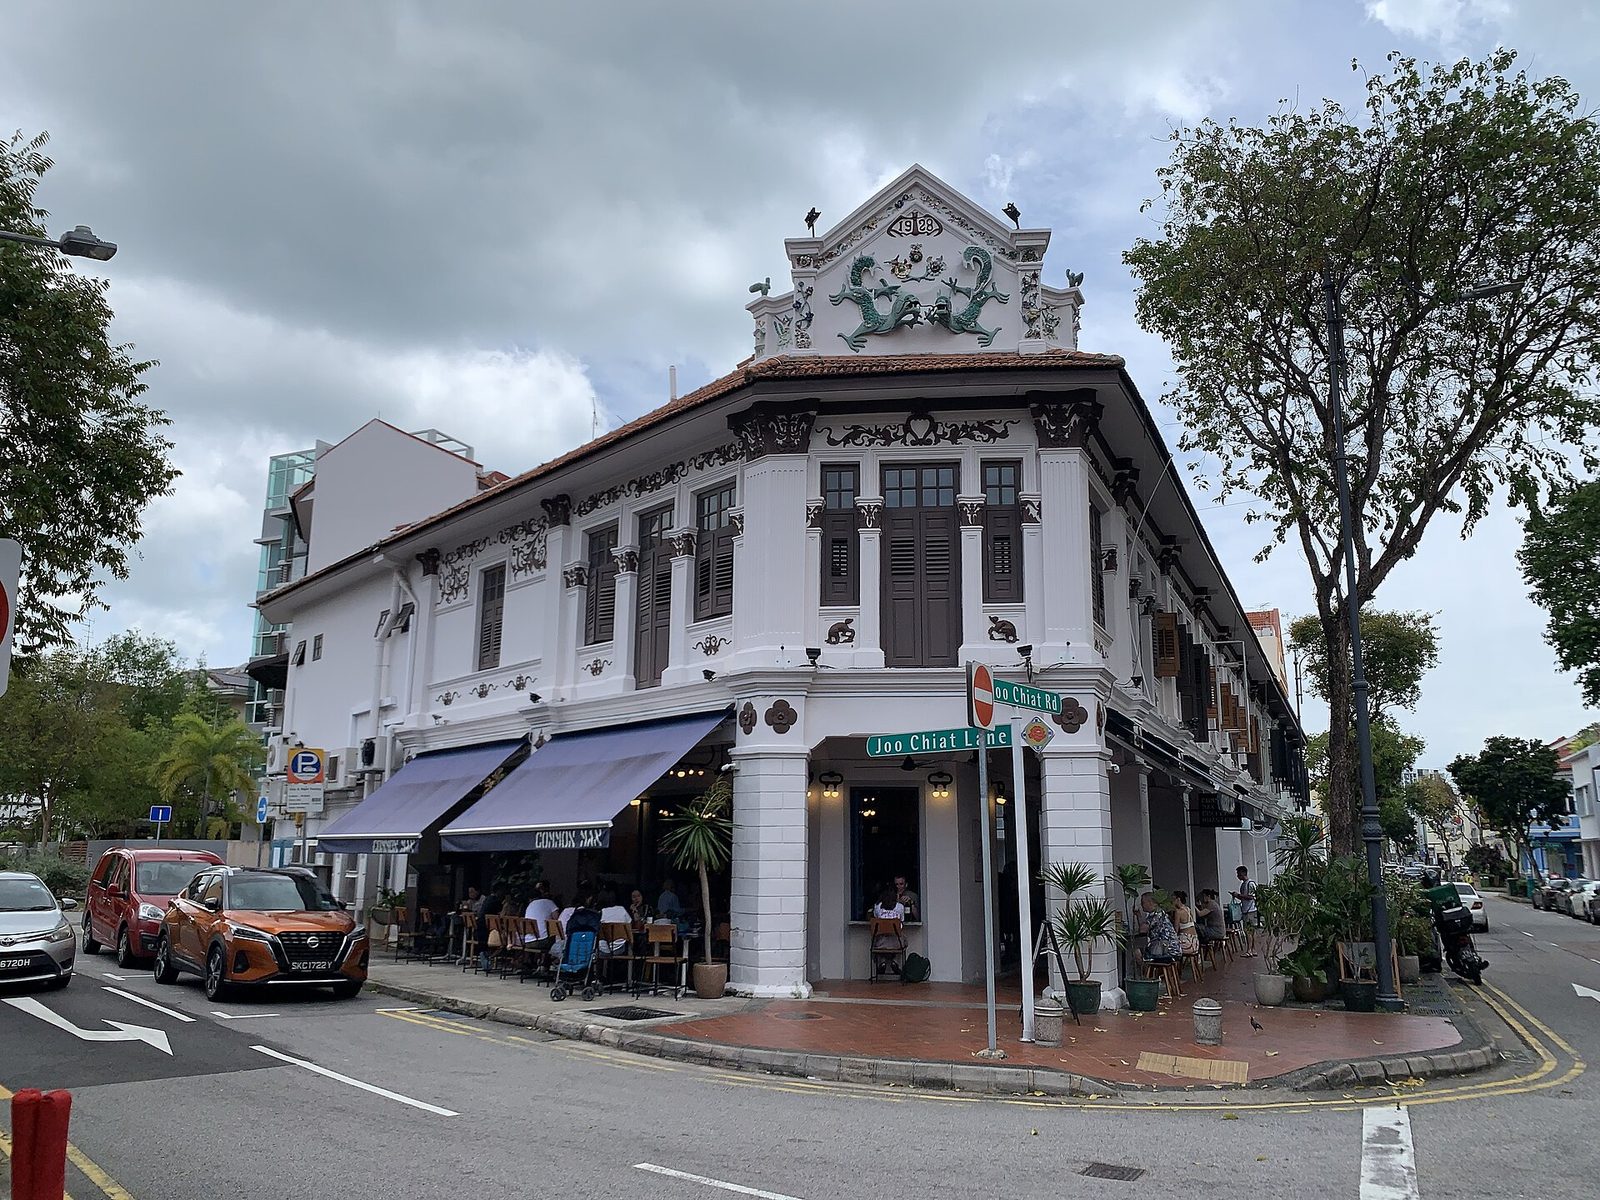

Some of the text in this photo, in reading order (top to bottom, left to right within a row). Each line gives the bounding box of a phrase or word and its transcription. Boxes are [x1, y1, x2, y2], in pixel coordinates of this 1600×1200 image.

[899, 219, 933, 231] 1928
[995, 686, 1058, 711] oo Chiat Rd
[875, 738, 902, 754] Joo
[910, 733, 957, 751] Chiat
[535, 830, 576, 849] COMMON
[291, 961, 333, 970] SKC1722Y
